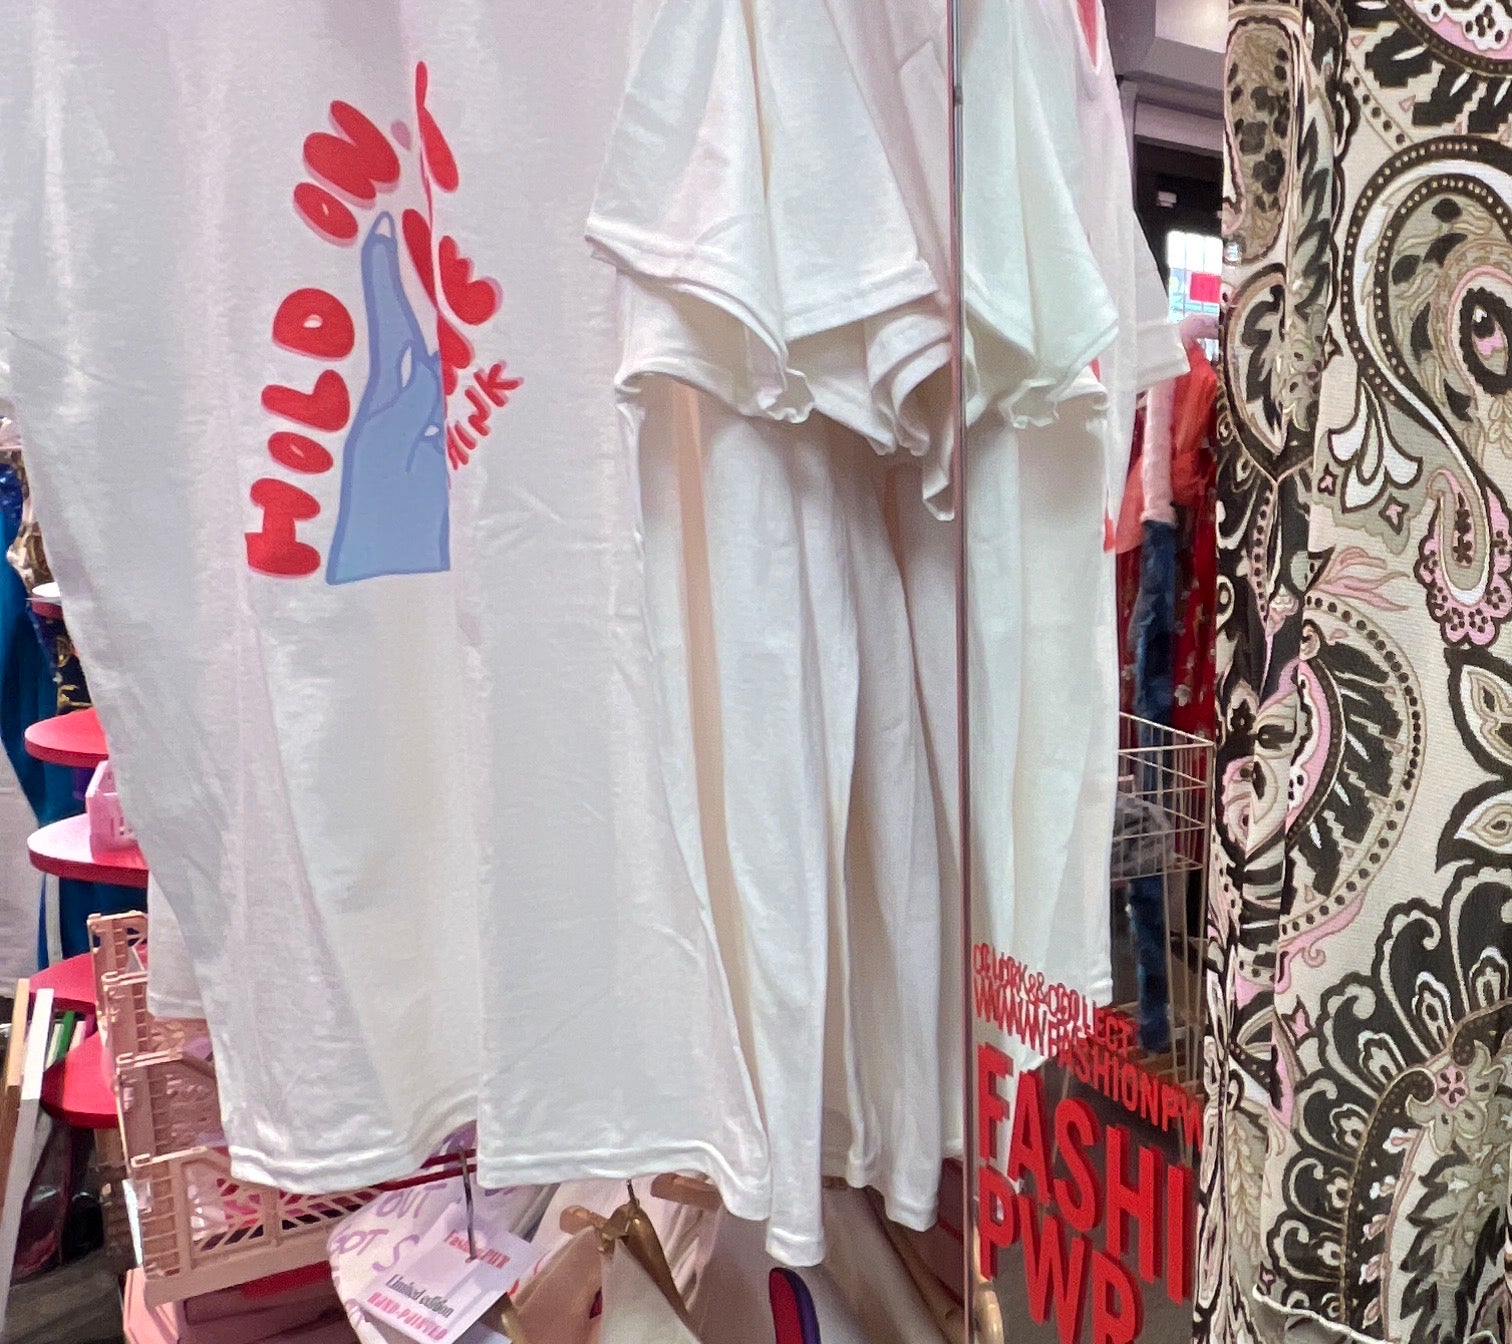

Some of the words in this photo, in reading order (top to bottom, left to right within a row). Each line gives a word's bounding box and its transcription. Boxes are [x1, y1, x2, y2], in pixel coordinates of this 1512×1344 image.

[243, 288, 356, 579] HOLD
[385, 1273, 425, 1301] Limited
[418, 1290, 455, 1319] edition
